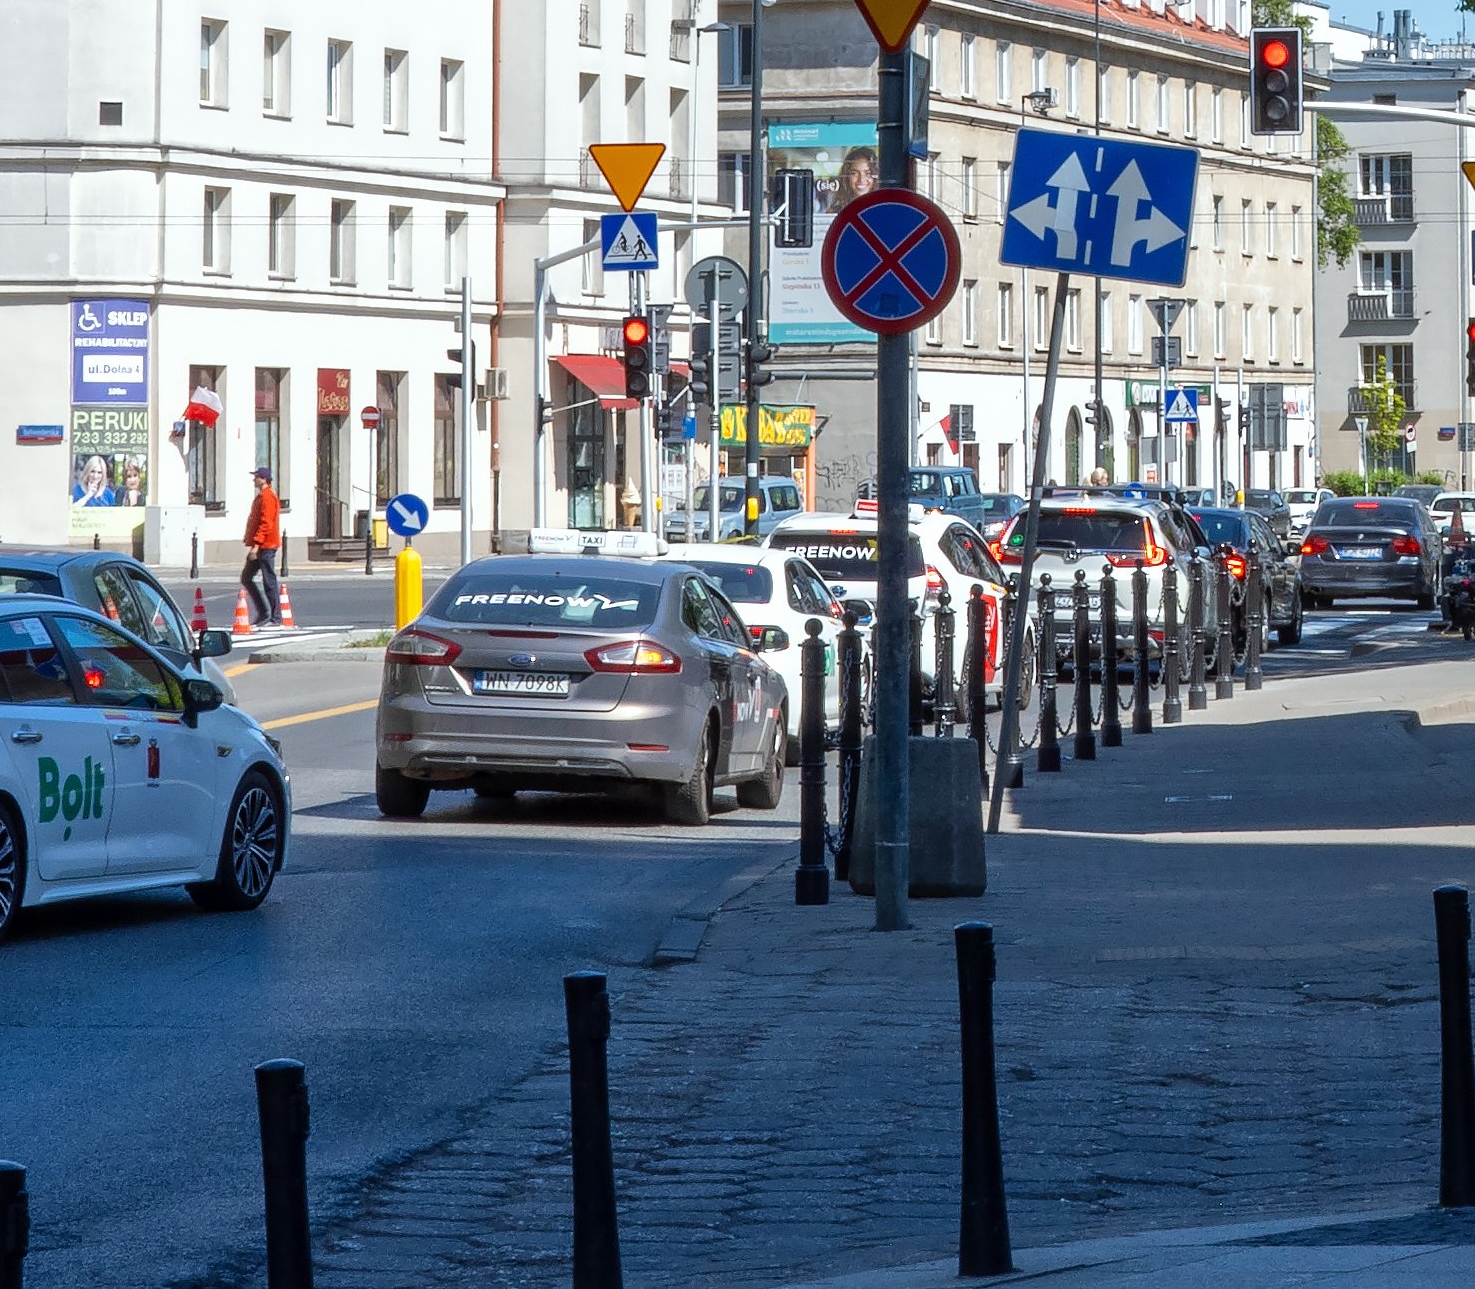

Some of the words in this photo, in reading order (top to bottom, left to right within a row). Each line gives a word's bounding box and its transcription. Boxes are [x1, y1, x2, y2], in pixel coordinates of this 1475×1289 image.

[107, 311, 147, 326] SKLEP
[73, 412, 147, 430] PERUKI
[73, 432, 100, 444] 733
[104, 432, 127, 444] 332
[581, 536, 603, 545] TAXI
[785, 545, 876, 560] FREENOW
[455, 594, 595, 608] FREENOW
[485, 673, 512, 689] WN
[516, 674, 566, 692] 7098K
[38, 755, 105, 841] Bolt
